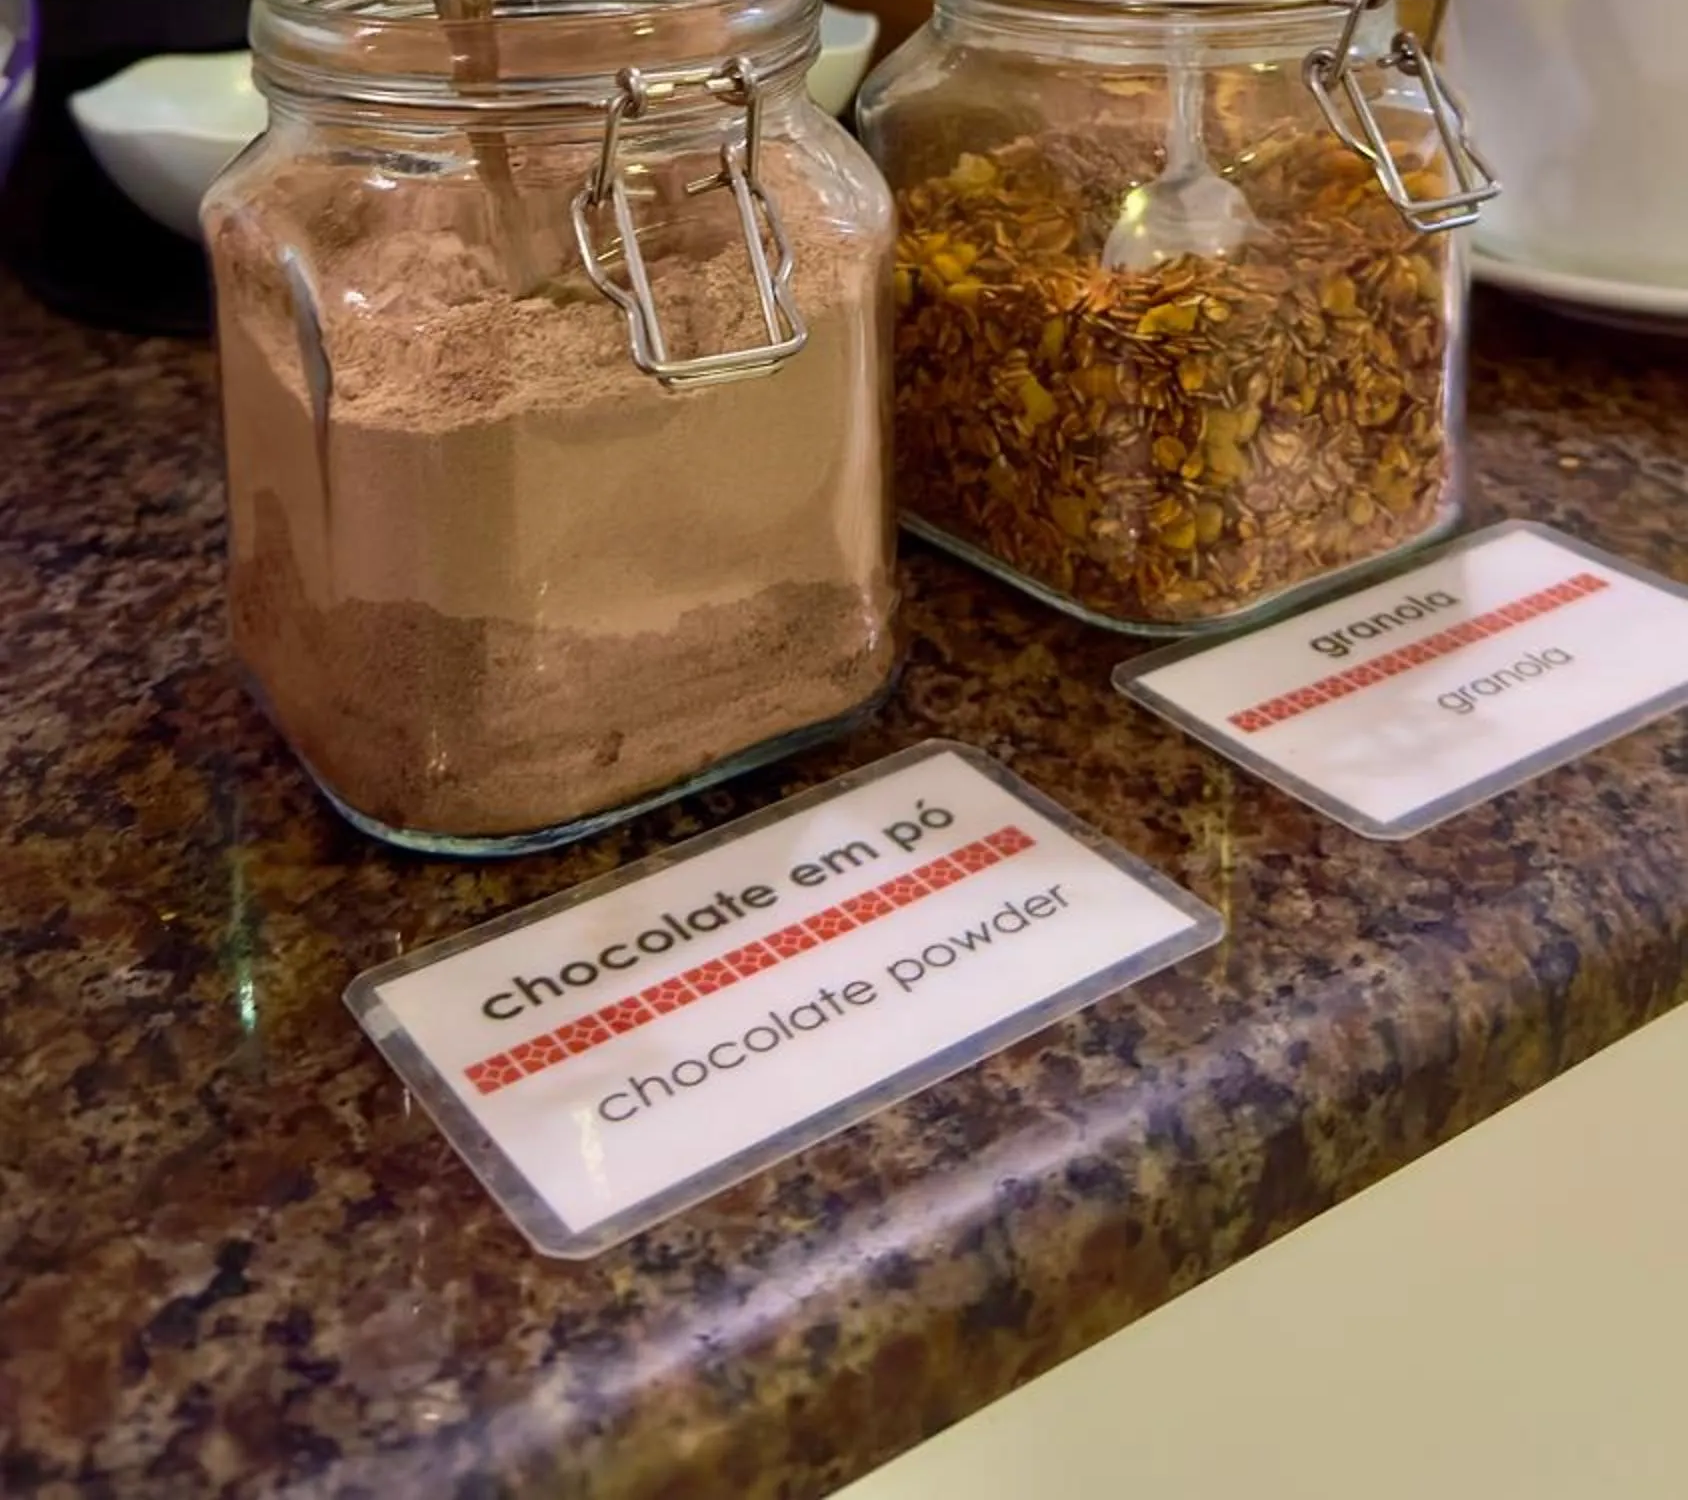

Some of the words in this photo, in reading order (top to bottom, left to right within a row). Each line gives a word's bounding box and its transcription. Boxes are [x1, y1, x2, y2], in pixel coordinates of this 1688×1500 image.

[1310, 587, 1461, 659] granola
[1437, 644, 1574, 716] granola
[481, 877, 779, 1023] chocolate
[788, 834, 880, 890] em
[883, 798, 956, 855] pó
[597, 977, 878, 1125] chocolate
[886, 881, 1073, 995] powder
